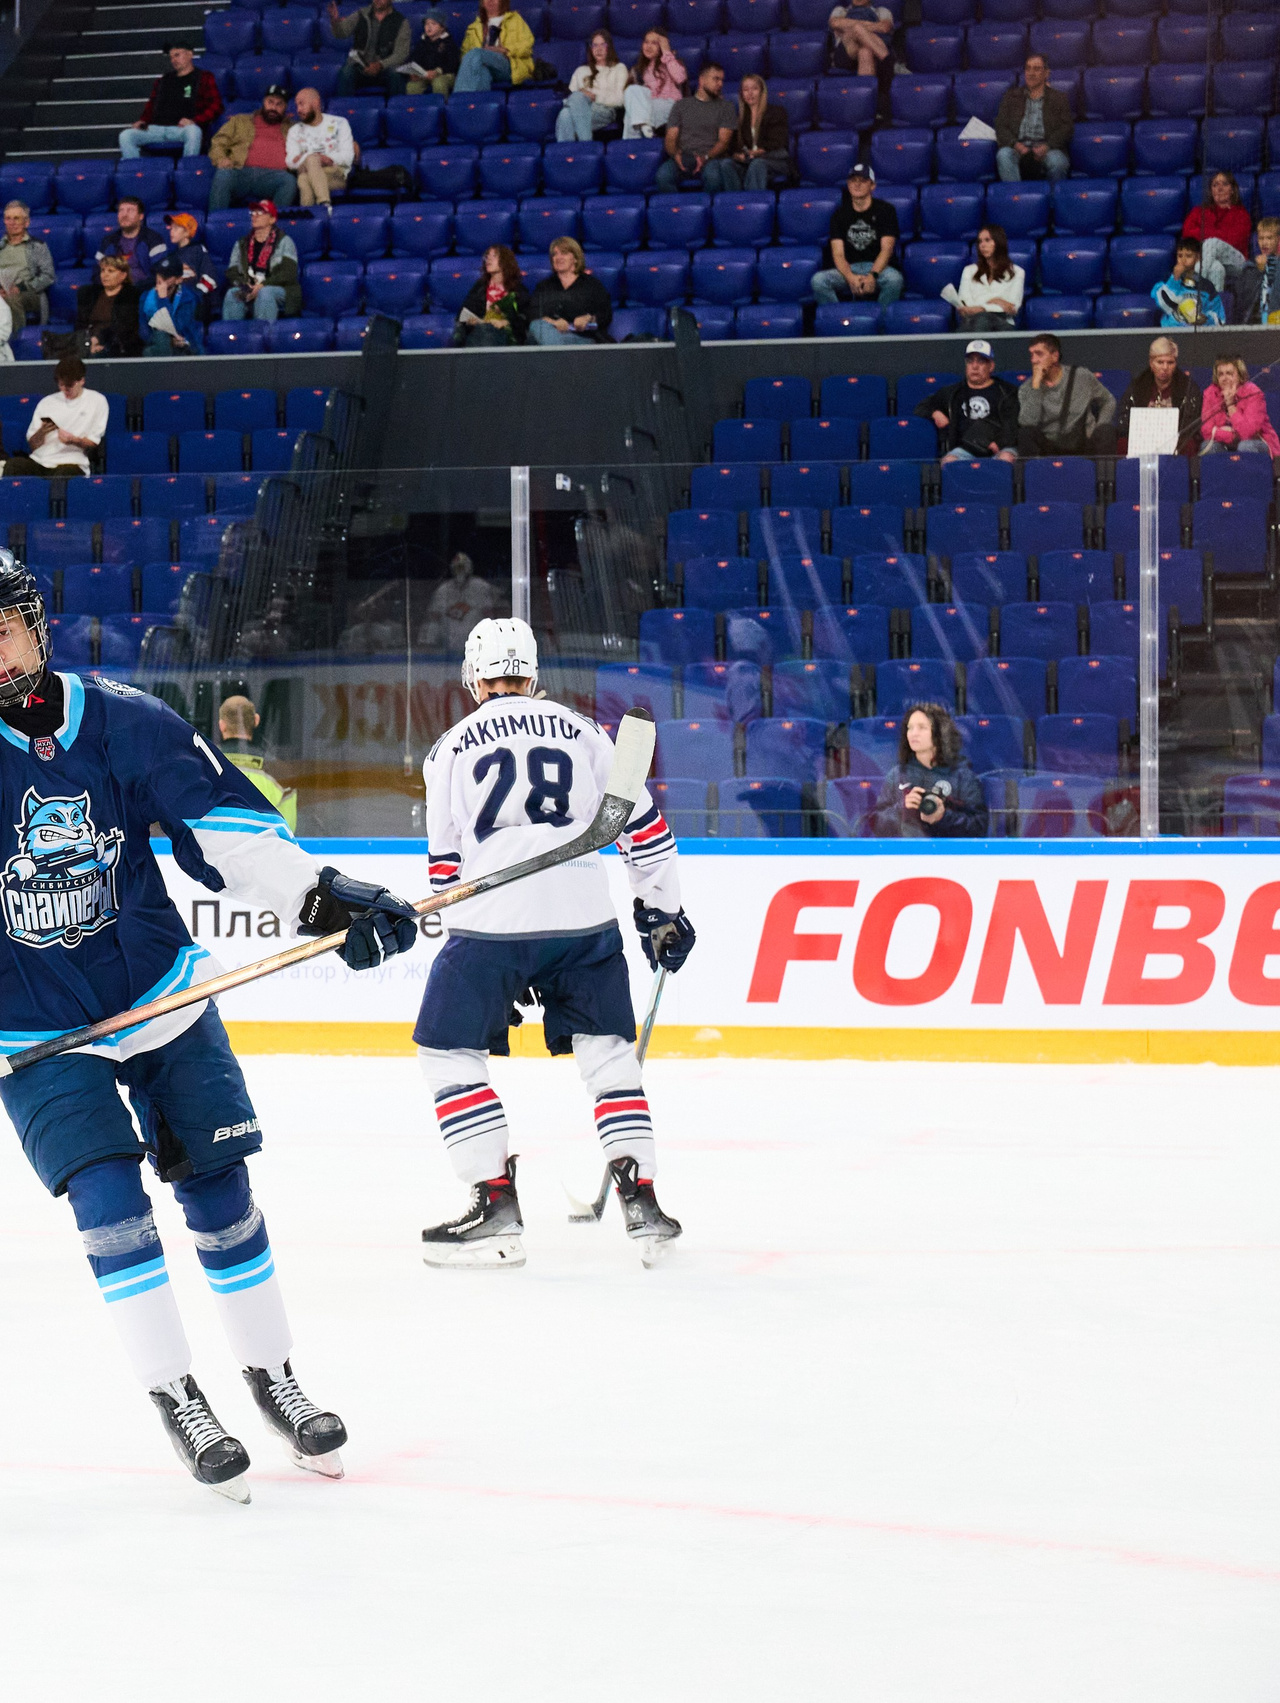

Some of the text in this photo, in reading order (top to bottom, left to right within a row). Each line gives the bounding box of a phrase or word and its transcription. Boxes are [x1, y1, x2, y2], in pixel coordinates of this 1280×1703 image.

[502, 659, 520, 675] 28
[473, 746, 574, 842] 28
[308, 894, 322, 924] CCM
